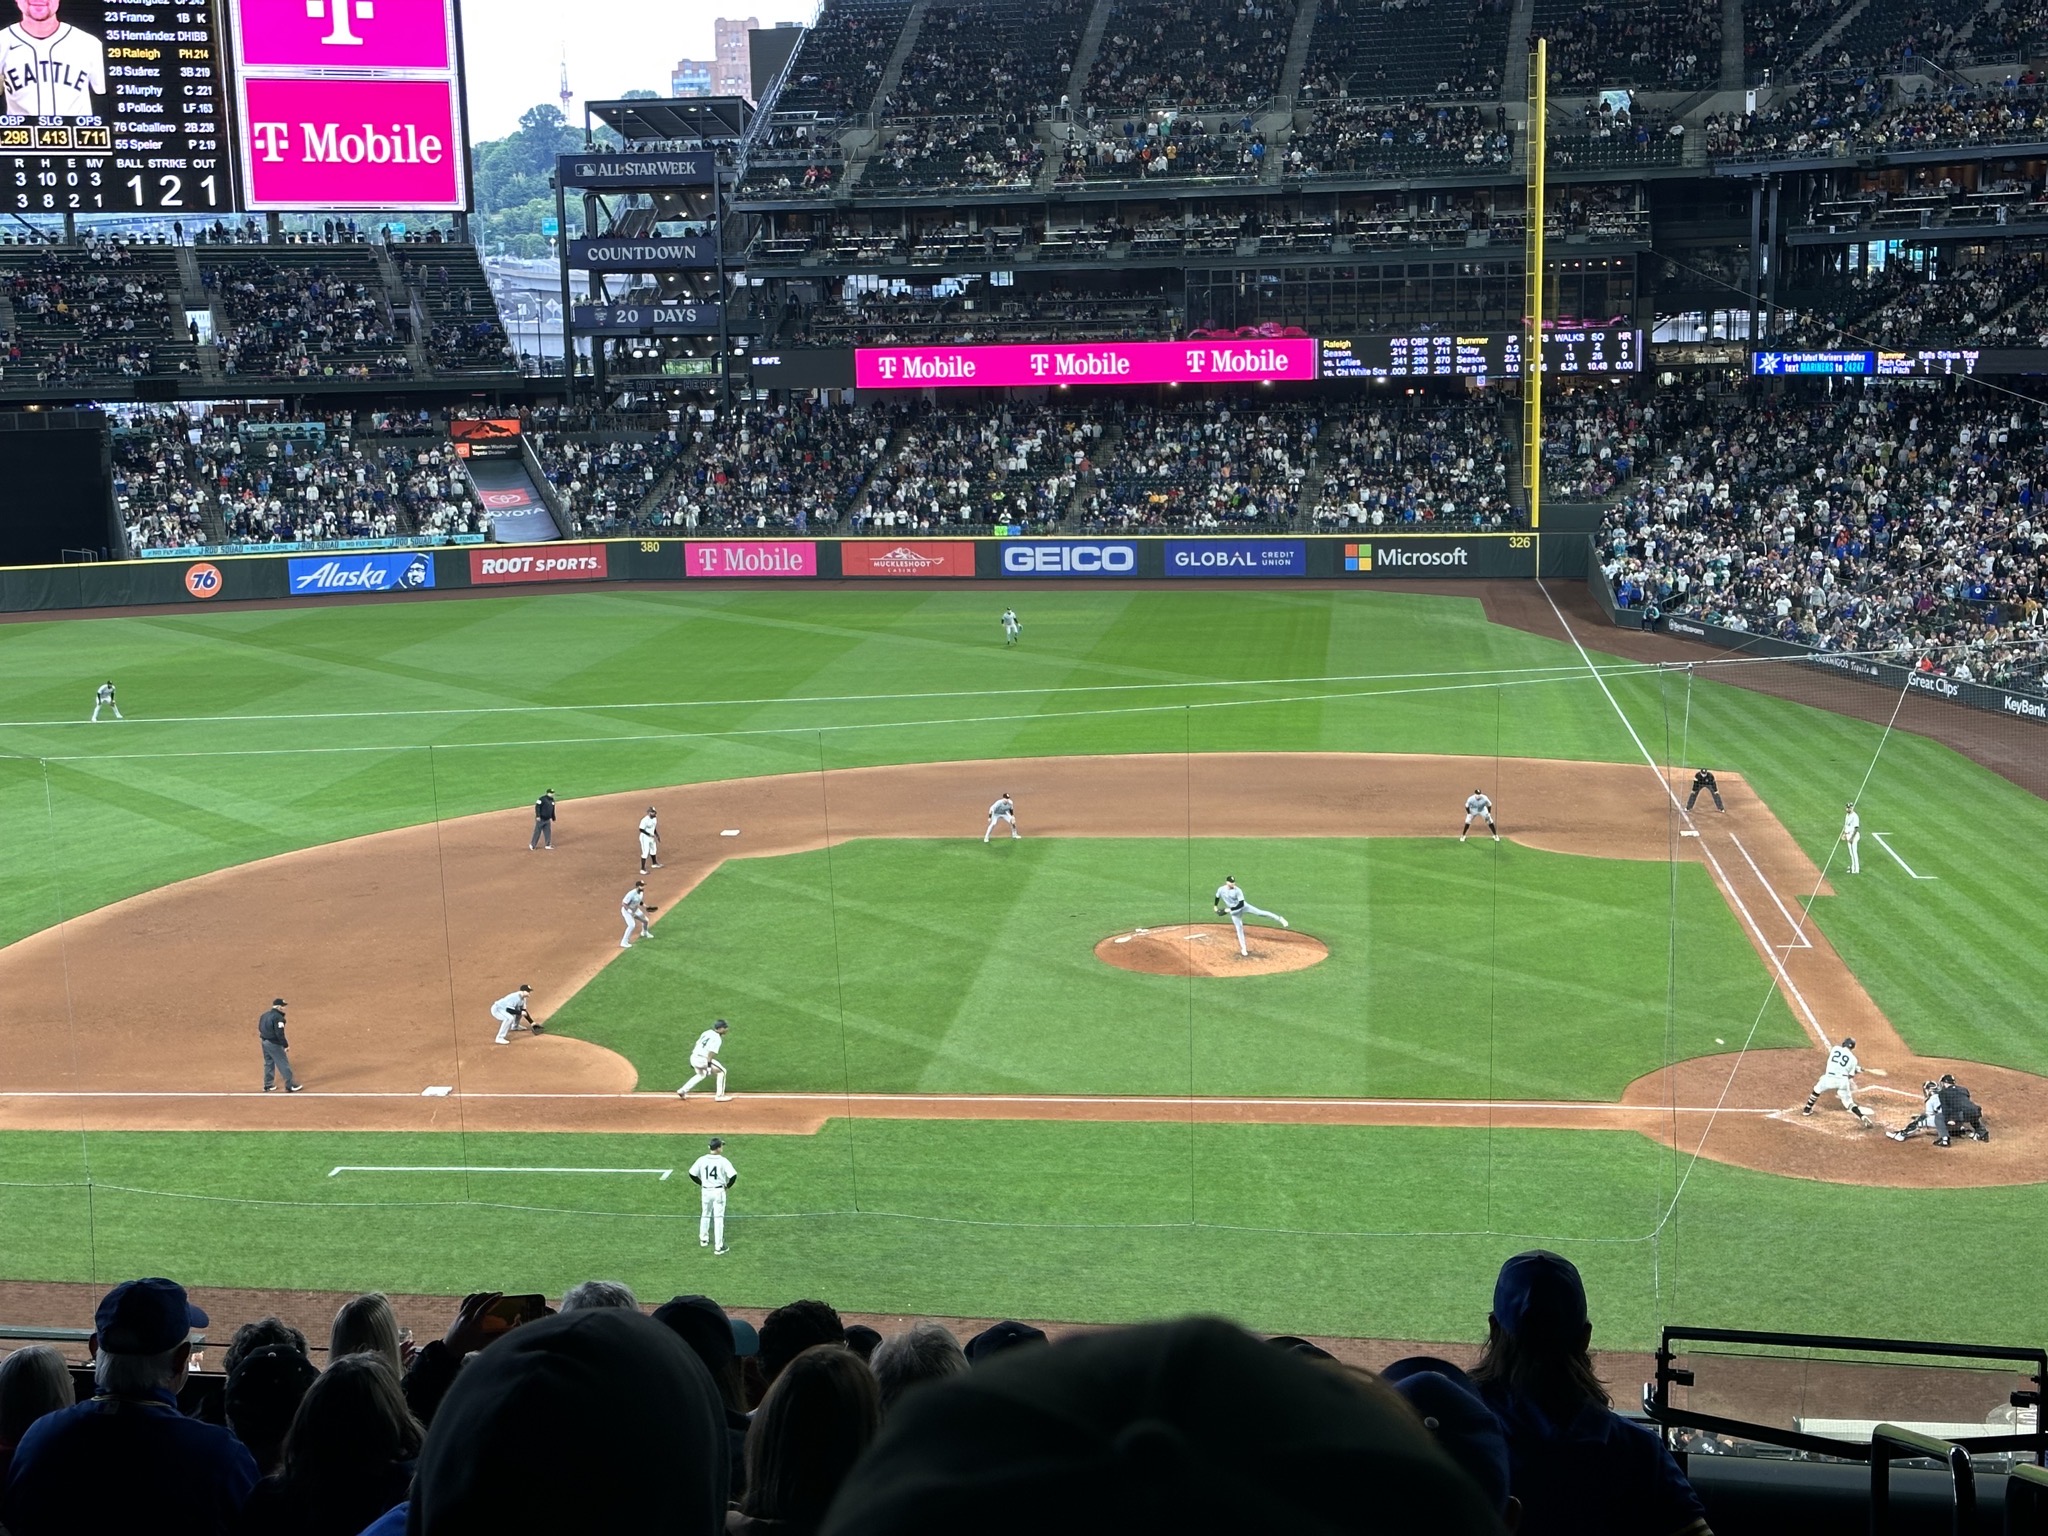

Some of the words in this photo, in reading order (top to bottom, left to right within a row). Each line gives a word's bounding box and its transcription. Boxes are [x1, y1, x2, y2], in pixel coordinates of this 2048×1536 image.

[104, 12, 118, 22] 23
[120, 12, 155, 22] France
[176, 13, 190, 23] 1B
[197, 14, 206, 23] K
[106, 30, 120, 40] 35
[108, 48, 121, 58] 29
[122, 48, 160, 60] Raleigh
[179, 49, 193, 58] PH
[109, 66, 123, 76] 28
[124, 66, 160, 76] Suárez
[180, 67, 194, 77] 3B
[116, 85, 124, 95] 2
[125, 85, 163, 97] Murphy
[184, 86, 193, 95] C
[118, 103, 125, 113] 8
[126, 103, 164, 113] Pollock
[183, 103, 197, 113] LF
[0, 115, 25, 126] OBP
[38, 116, 63, 126] SLG
[76, 116, 102, 126] OPS
[113, 122, 127, 132] 76
[128, 122, 176, 132] Caballero
[185, 123, 198, 133] 2B
[1, 130, 29, 145] .298
[40, 130, 68, 145] .413
[78, 131, 107, 145] .711
[253, 122, 289, 162] T
[299, 123, 443, 164] Mobile
[115, 140, 128, 149] 55
[130, 140, 163, 151] Speier
[188, 140, 197, 150] P
[199, 140, 216, 150] 2.19
[15, 159, 24, 168] R
[41, 159, 50, 168] H
[68, 159, 76, 168] E
[87, 159, 103, 168] MV
[117, 158, 144, 168] BALL
[148, 159, 187, 168] STRIKE
[193, 159, 216, 168] OUT
[656, 161, 696, 175] WEEK
[15, 172, 27, 186] 3
[38, 172, 57, 186] 10
[67, 172, 78, 186] 0
[91, 172, 101, 186] 3
[127, 175, 143, 207] 1
[159, 175, 183, 206] 2
[200, 175, 216, 206] 1
[17, 194, 28, 208] 3
[43, 194, 54, 208] 8
[69, 194, 80, 208] 2
[94, 194, 102, 208] 1
[587, 245, 696, 261] COUNTDOWN
[616, 309, 639, 323] 20
[653, 308, 697, 323] DAYS
[1323, 340, 1351, 349] Raleigh
[1390, 338, 1408, 346] AVG
[1411, 338, 1429, 346] OBP
[1433, 337, 1451, 345] OPS
[1456, 337, 1489, 345] Bummer
[1508, 335, 1518, 344] IP
[1555, 334, 1585, 342] WALKS
[1591, 333, 1605, 341] SO
[1618, 332, 1631, 341] HR
[1323, 350, 1352, 358] Season
[1390, 348, 1407, 356] .214
[1456, 346, 1480, 355] Today
[1506, 345, 1519, 353] 0.2
[1962, 351, 1979, 359] Total
[1030, 353, 1049, 376] T
[1054, 352, 1130, 375] Mobile
[1186, 350, 1205, 373] T
[1210, 349, 1288, 373] Mobile
[1456, 356, 1486, 364] Season
[1504, 355, 1521, 363] 22.1
[1565, 352, 1575, 361] 13
[878, 357, 896, 379] T
[901, 355, 976, 378] Mobile
[1336, 368, 1349, 376] Chi
[1350, 368, 1371, 376] White
[1372, 367, 1387, 375] Sox
[1456, 365, 1470, 374] Per
[1615, 361, 1633, 370] 0.00
[1785, 363, 1799, 373] text
[1800, 362, 1833, 373] MARINERS
[1835, 363, 1843, 372] to
[1844, 362, 1865, 373] 24247
[489, 507, 545, 518] OYOTA
[641, 542, 660, 553] 380
[1509, 537, 1531, 548] 326
[698, 548, 717, 571] T
[723, 547, 803, 571] Mobile
[1004, 546, 1134, 571] GEICO
[1175, 551, 1257, 566] GLOBAL
[1378, 547, 1467, 566] Microsoft
[482, 557, 534, 574] ROOT
[535, 557, 597, 572] SPORTS
[191, 569, 218, 591] 76
[296, 561, 388, 589] Alaska
[1908, 671, 1934, 690] Great
[1935, 678, 1959, 697] Clips
[2005, 695, 2047, 718] KeyBank
[1831, 1050, 1850, 1067] 29
[705, 1165, 718, 1180] 14
